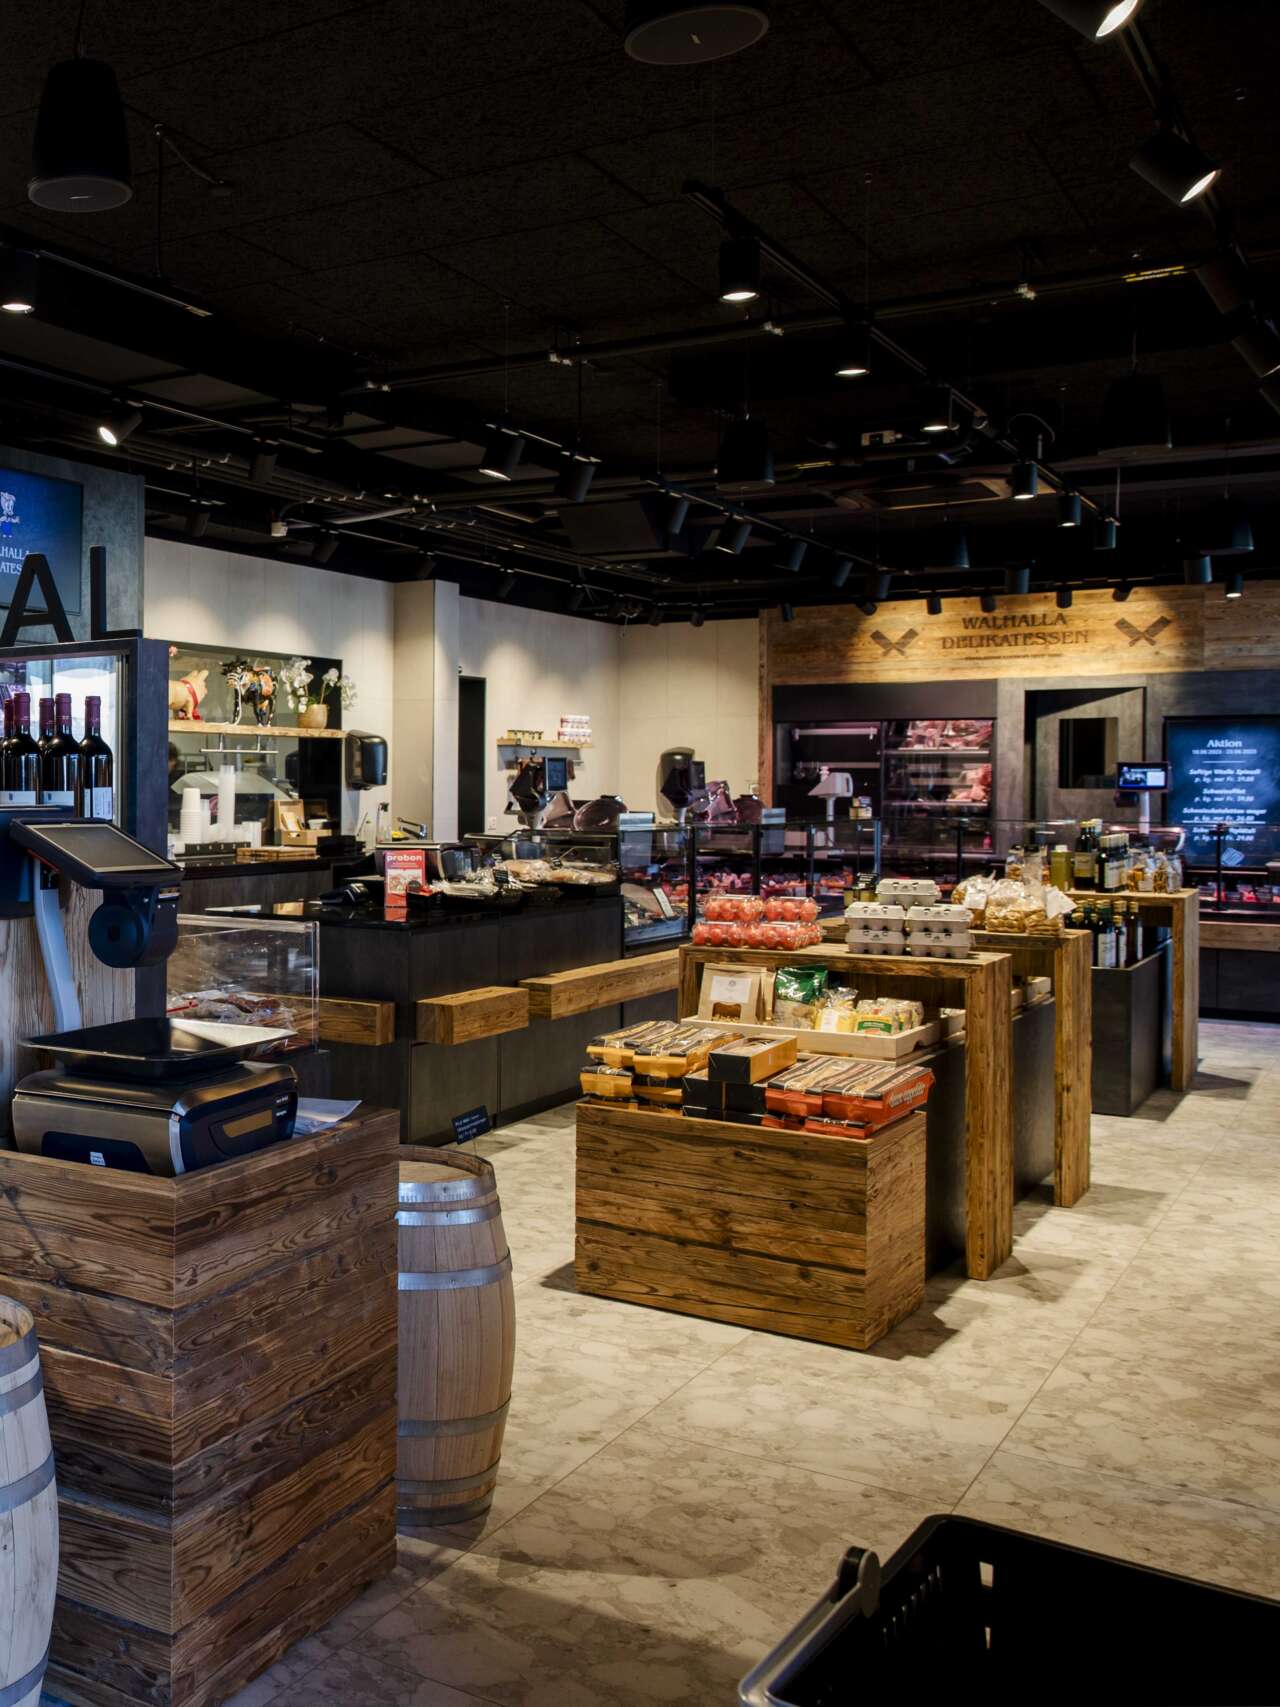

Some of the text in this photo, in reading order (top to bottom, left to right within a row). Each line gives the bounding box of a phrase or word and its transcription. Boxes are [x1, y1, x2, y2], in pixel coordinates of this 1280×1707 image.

[962, 612, 1067, 630] WALHALLA
[942, 630, 1089, 650] DELIKATESSEN
[1207, 739, 1242, 748] Aktion
[386, 854, 423, 862] probon
